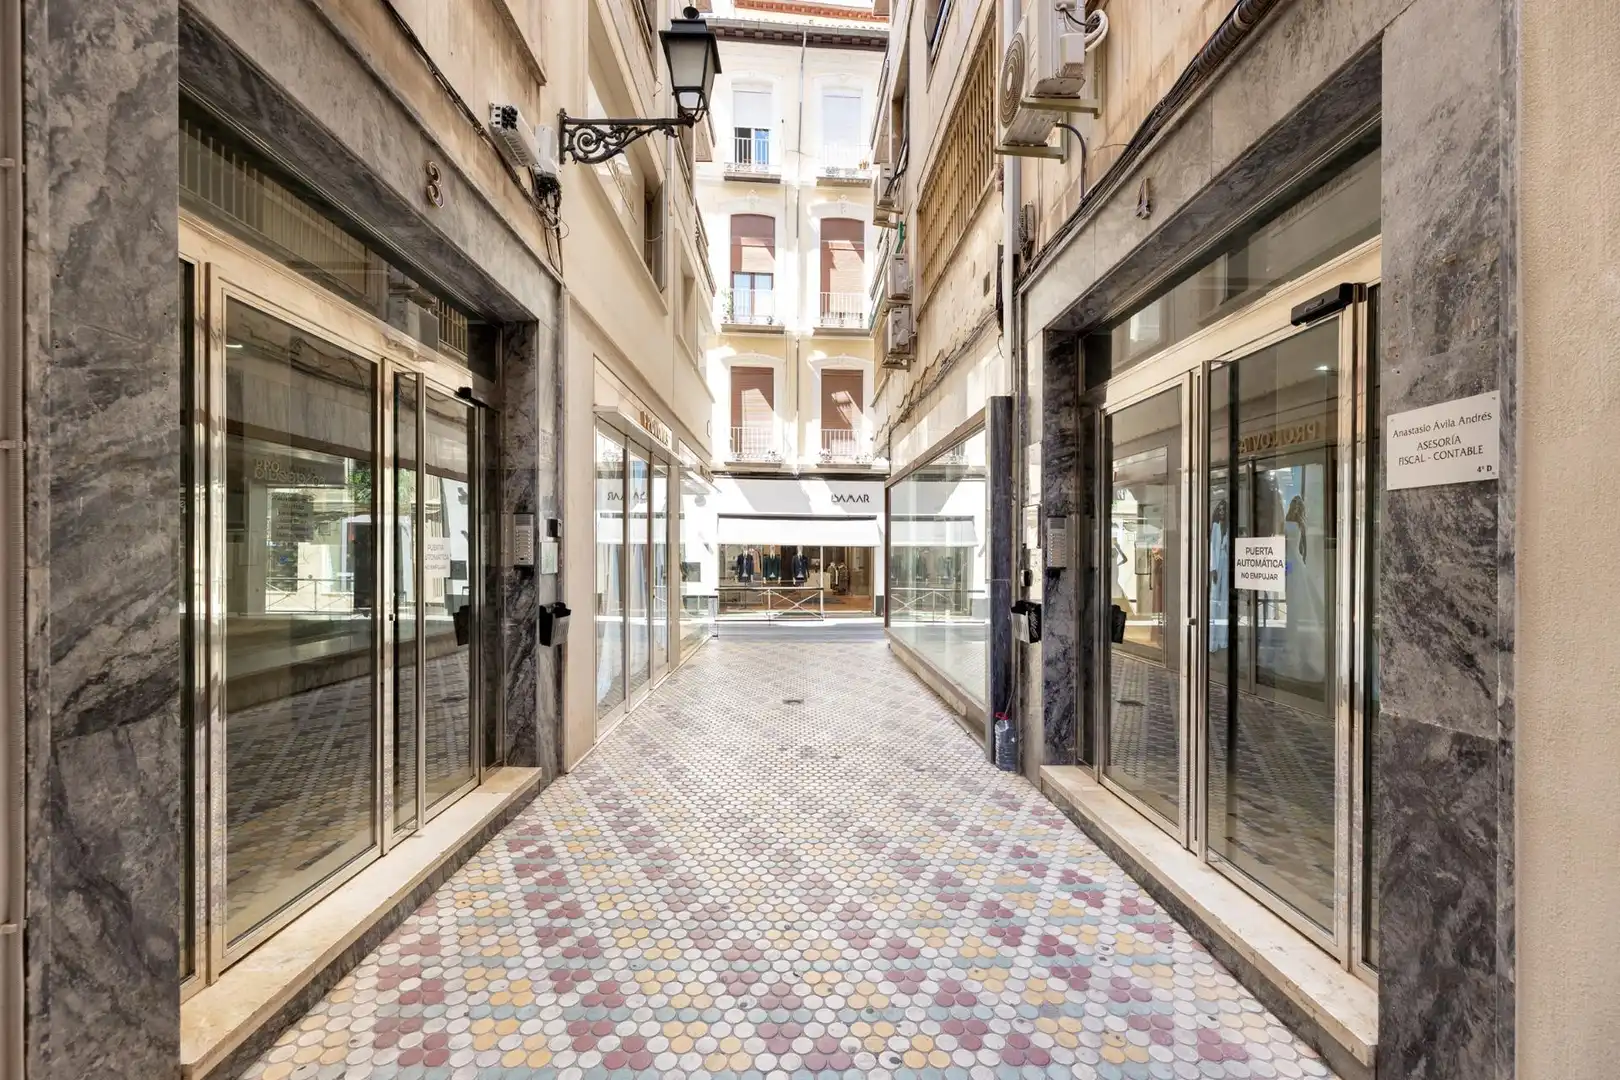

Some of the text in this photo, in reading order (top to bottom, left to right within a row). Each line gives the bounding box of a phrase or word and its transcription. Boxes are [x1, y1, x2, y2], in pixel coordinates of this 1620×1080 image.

[425, 160, 444, 208] 3
[1393, 424, 1431, 438] Anastasio
[1458, 411, 1492, 425] Andrés
[1417, 434, 1461, 451] ASESORÍA
[1398, 455, 1425, 466] FISCAL
[1433, 445, 1483, 461] CONTABLE
[1245, 546, 1273, 555] PUERTA
[1236, 557, 1284, 568] AUTOMÁTICA
[1250, 572, 1279, 580] EMPUJAR
